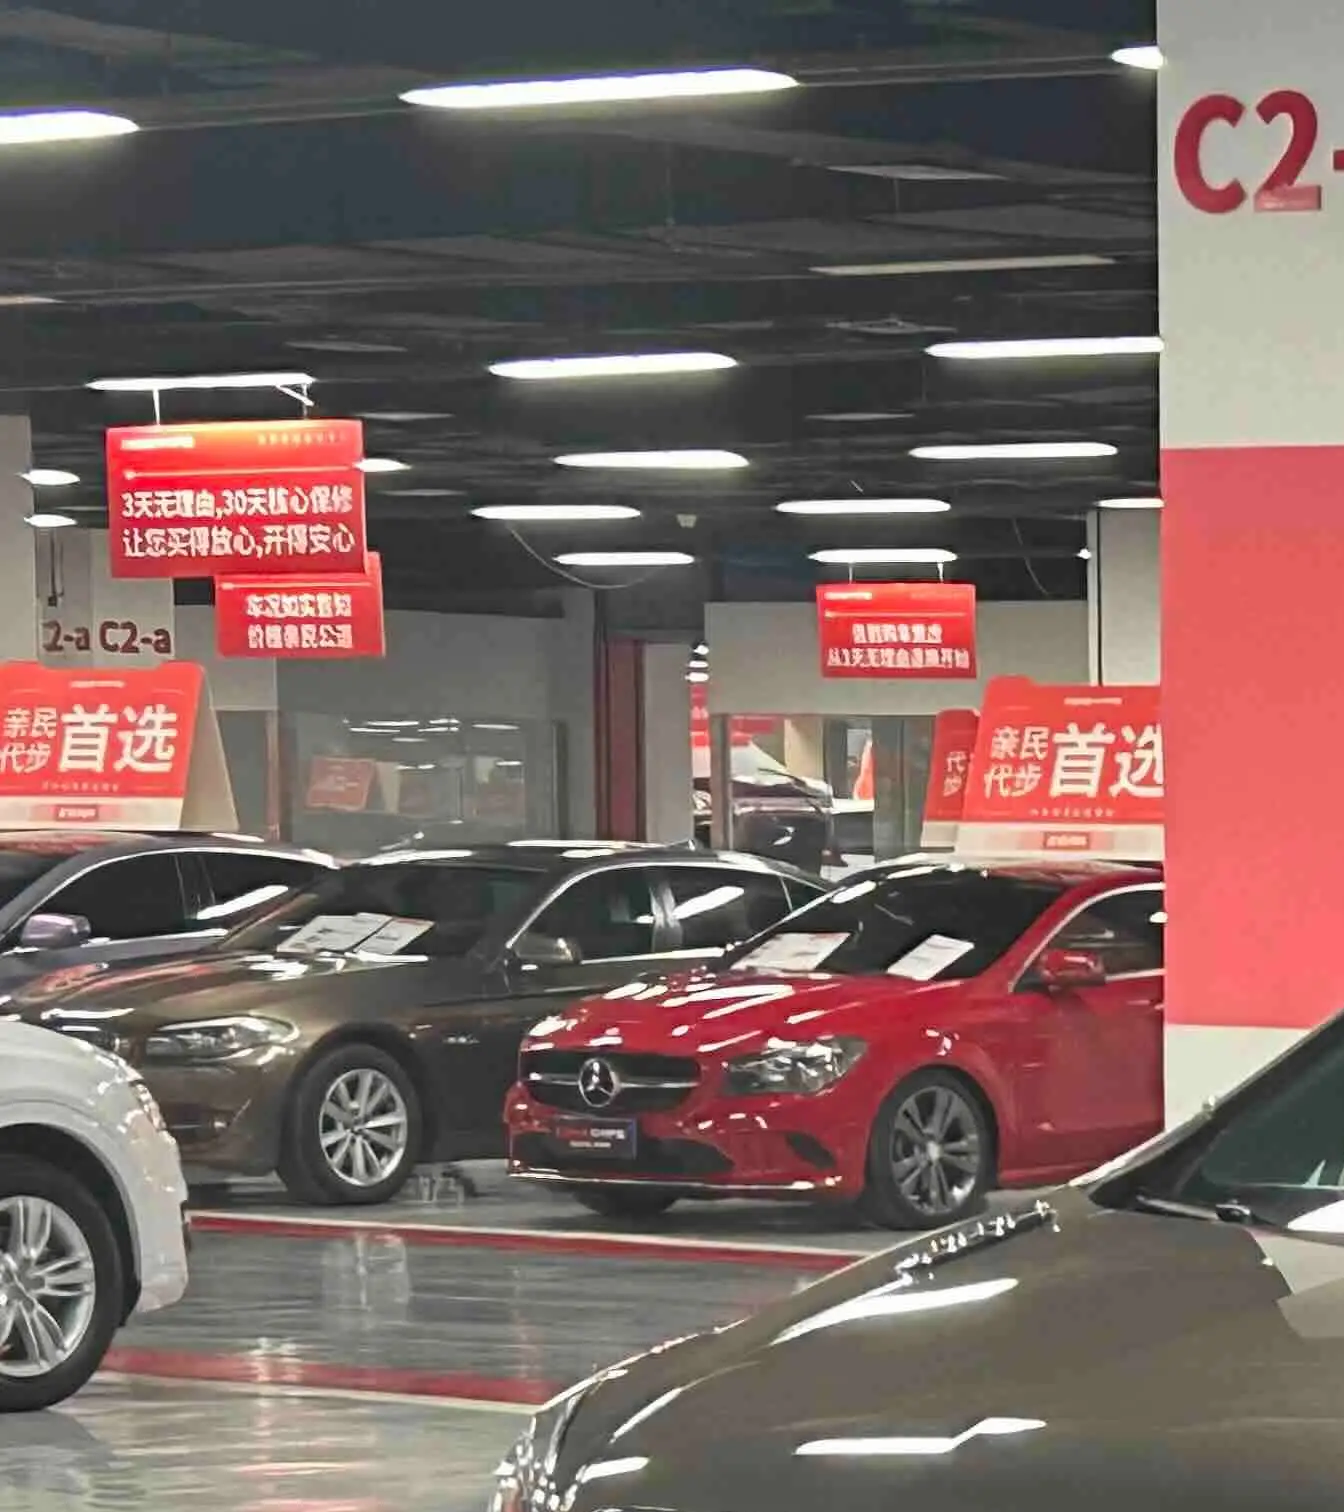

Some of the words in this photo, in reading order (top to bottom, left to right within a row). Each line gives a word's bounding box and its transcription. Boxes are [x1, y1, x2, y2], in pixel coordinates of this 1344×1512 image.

[42, 620, 91, 652] 2-a
[99, 620, 172, 654] C2-a
[3, 707, 57, 739] 亲民
[57, 703, 179, 773] 首选
[0, 741, 51, 774] 代步
[990, 726, 1049, 760] 亲民
[1048, 722, 1165, 799] 首选
[983, 763, 1043, 799] 代步
